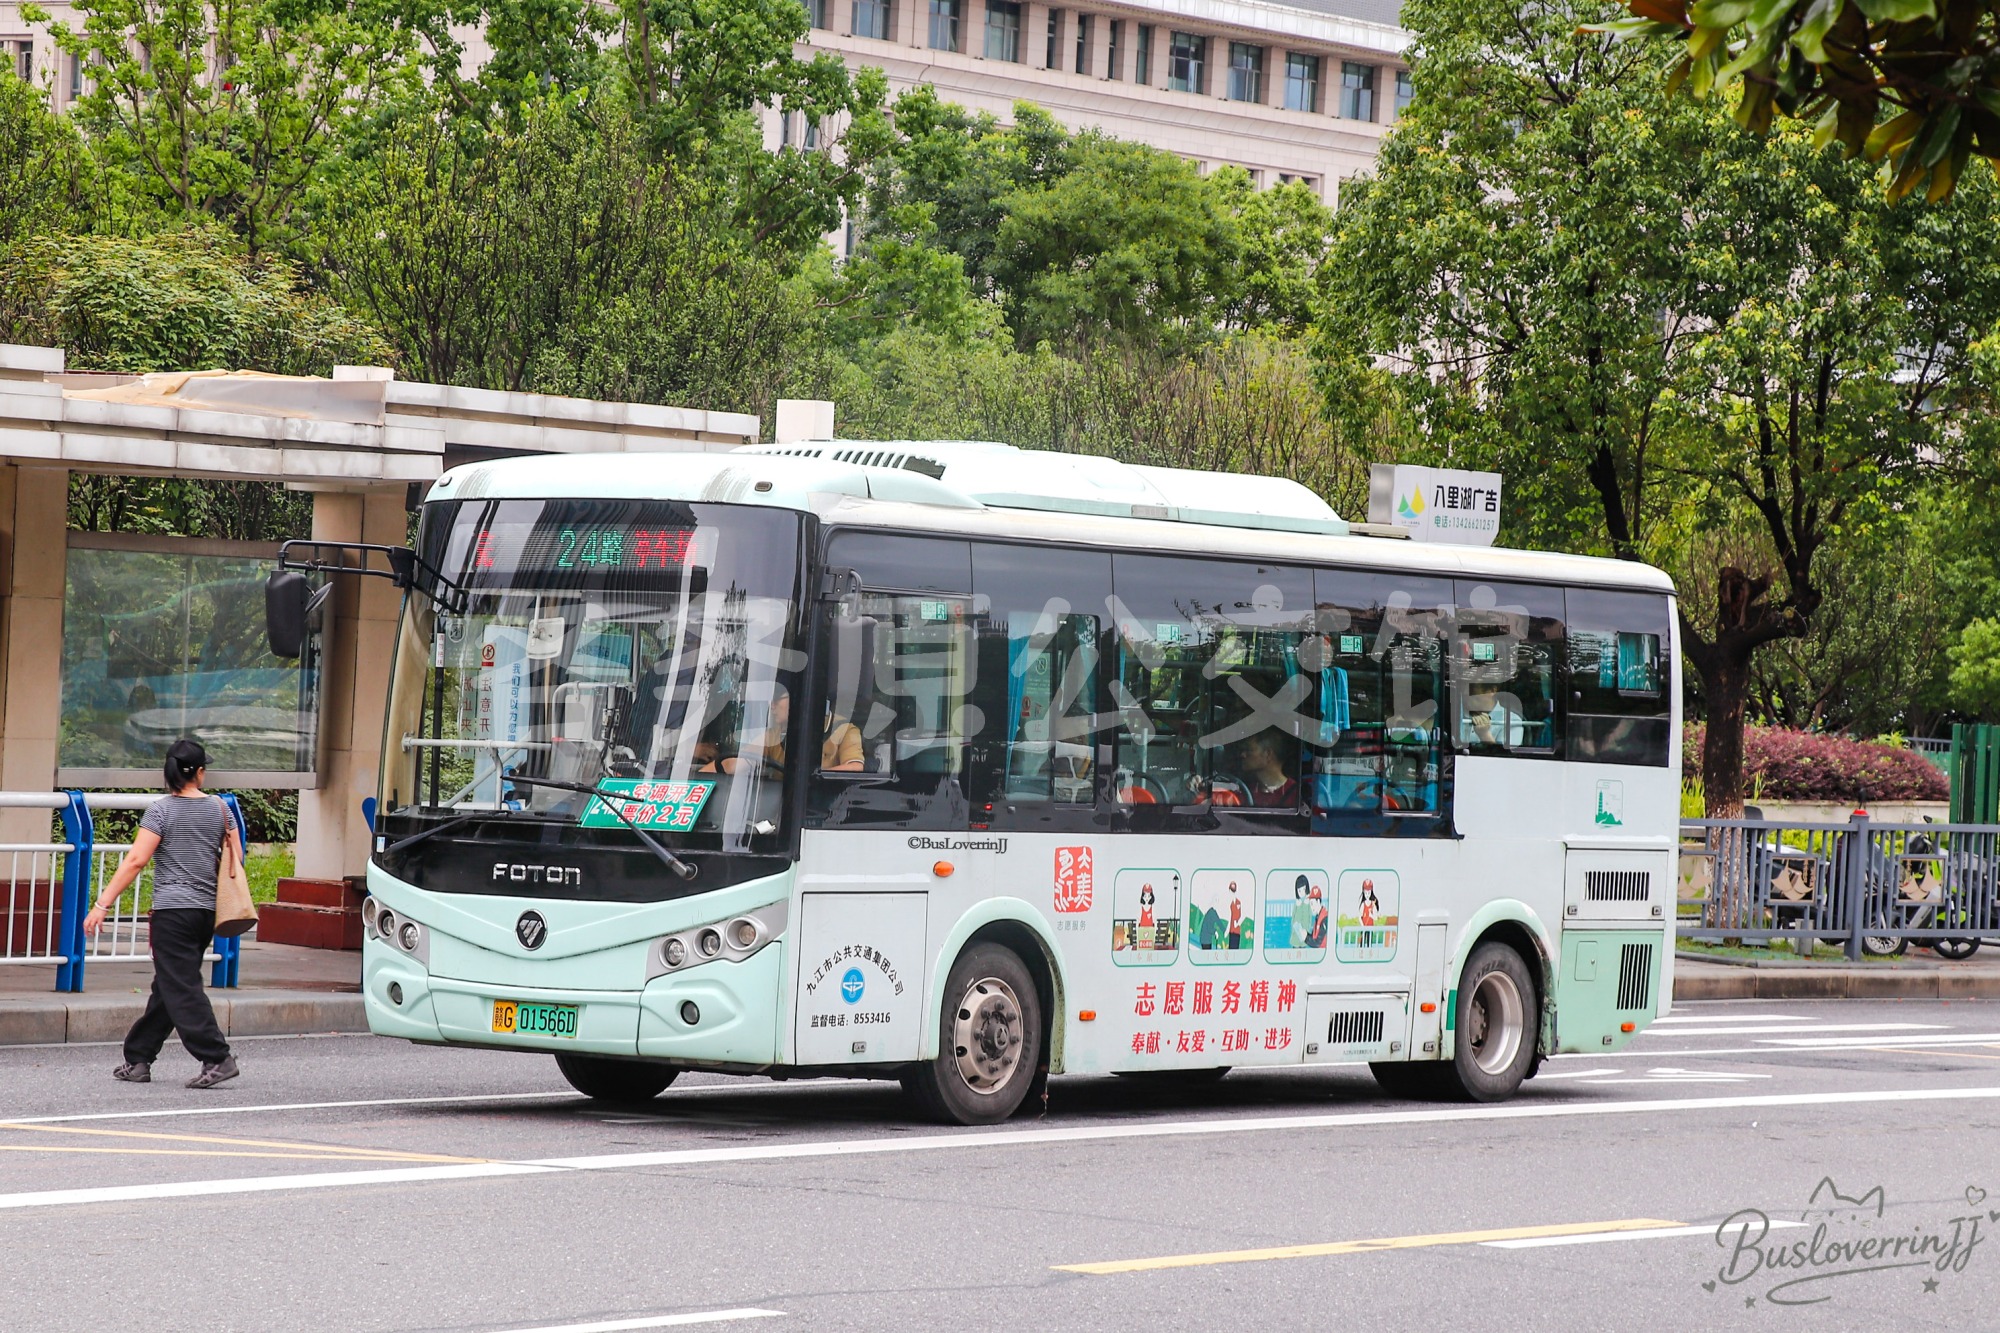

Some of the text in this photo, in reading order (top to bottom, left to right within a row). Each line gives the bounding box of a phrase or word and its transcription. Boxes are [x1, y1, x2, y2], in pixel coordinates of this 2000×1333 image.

[1434, 484, 1498, 512] 八里湖广告
[557, 530, 623, 567] 24路
[633, 784, 707, 804] 空调开启
[617, 803, 695, 826] 票价2元
[492, 863, 581, 885] FOTON
[1056, 919, 1087, 931] 志愿服务
[806, 944, 904, 996] 九江市公共交通集团公司
[1134, 979, 1298, 1017] 志愿服务精神
